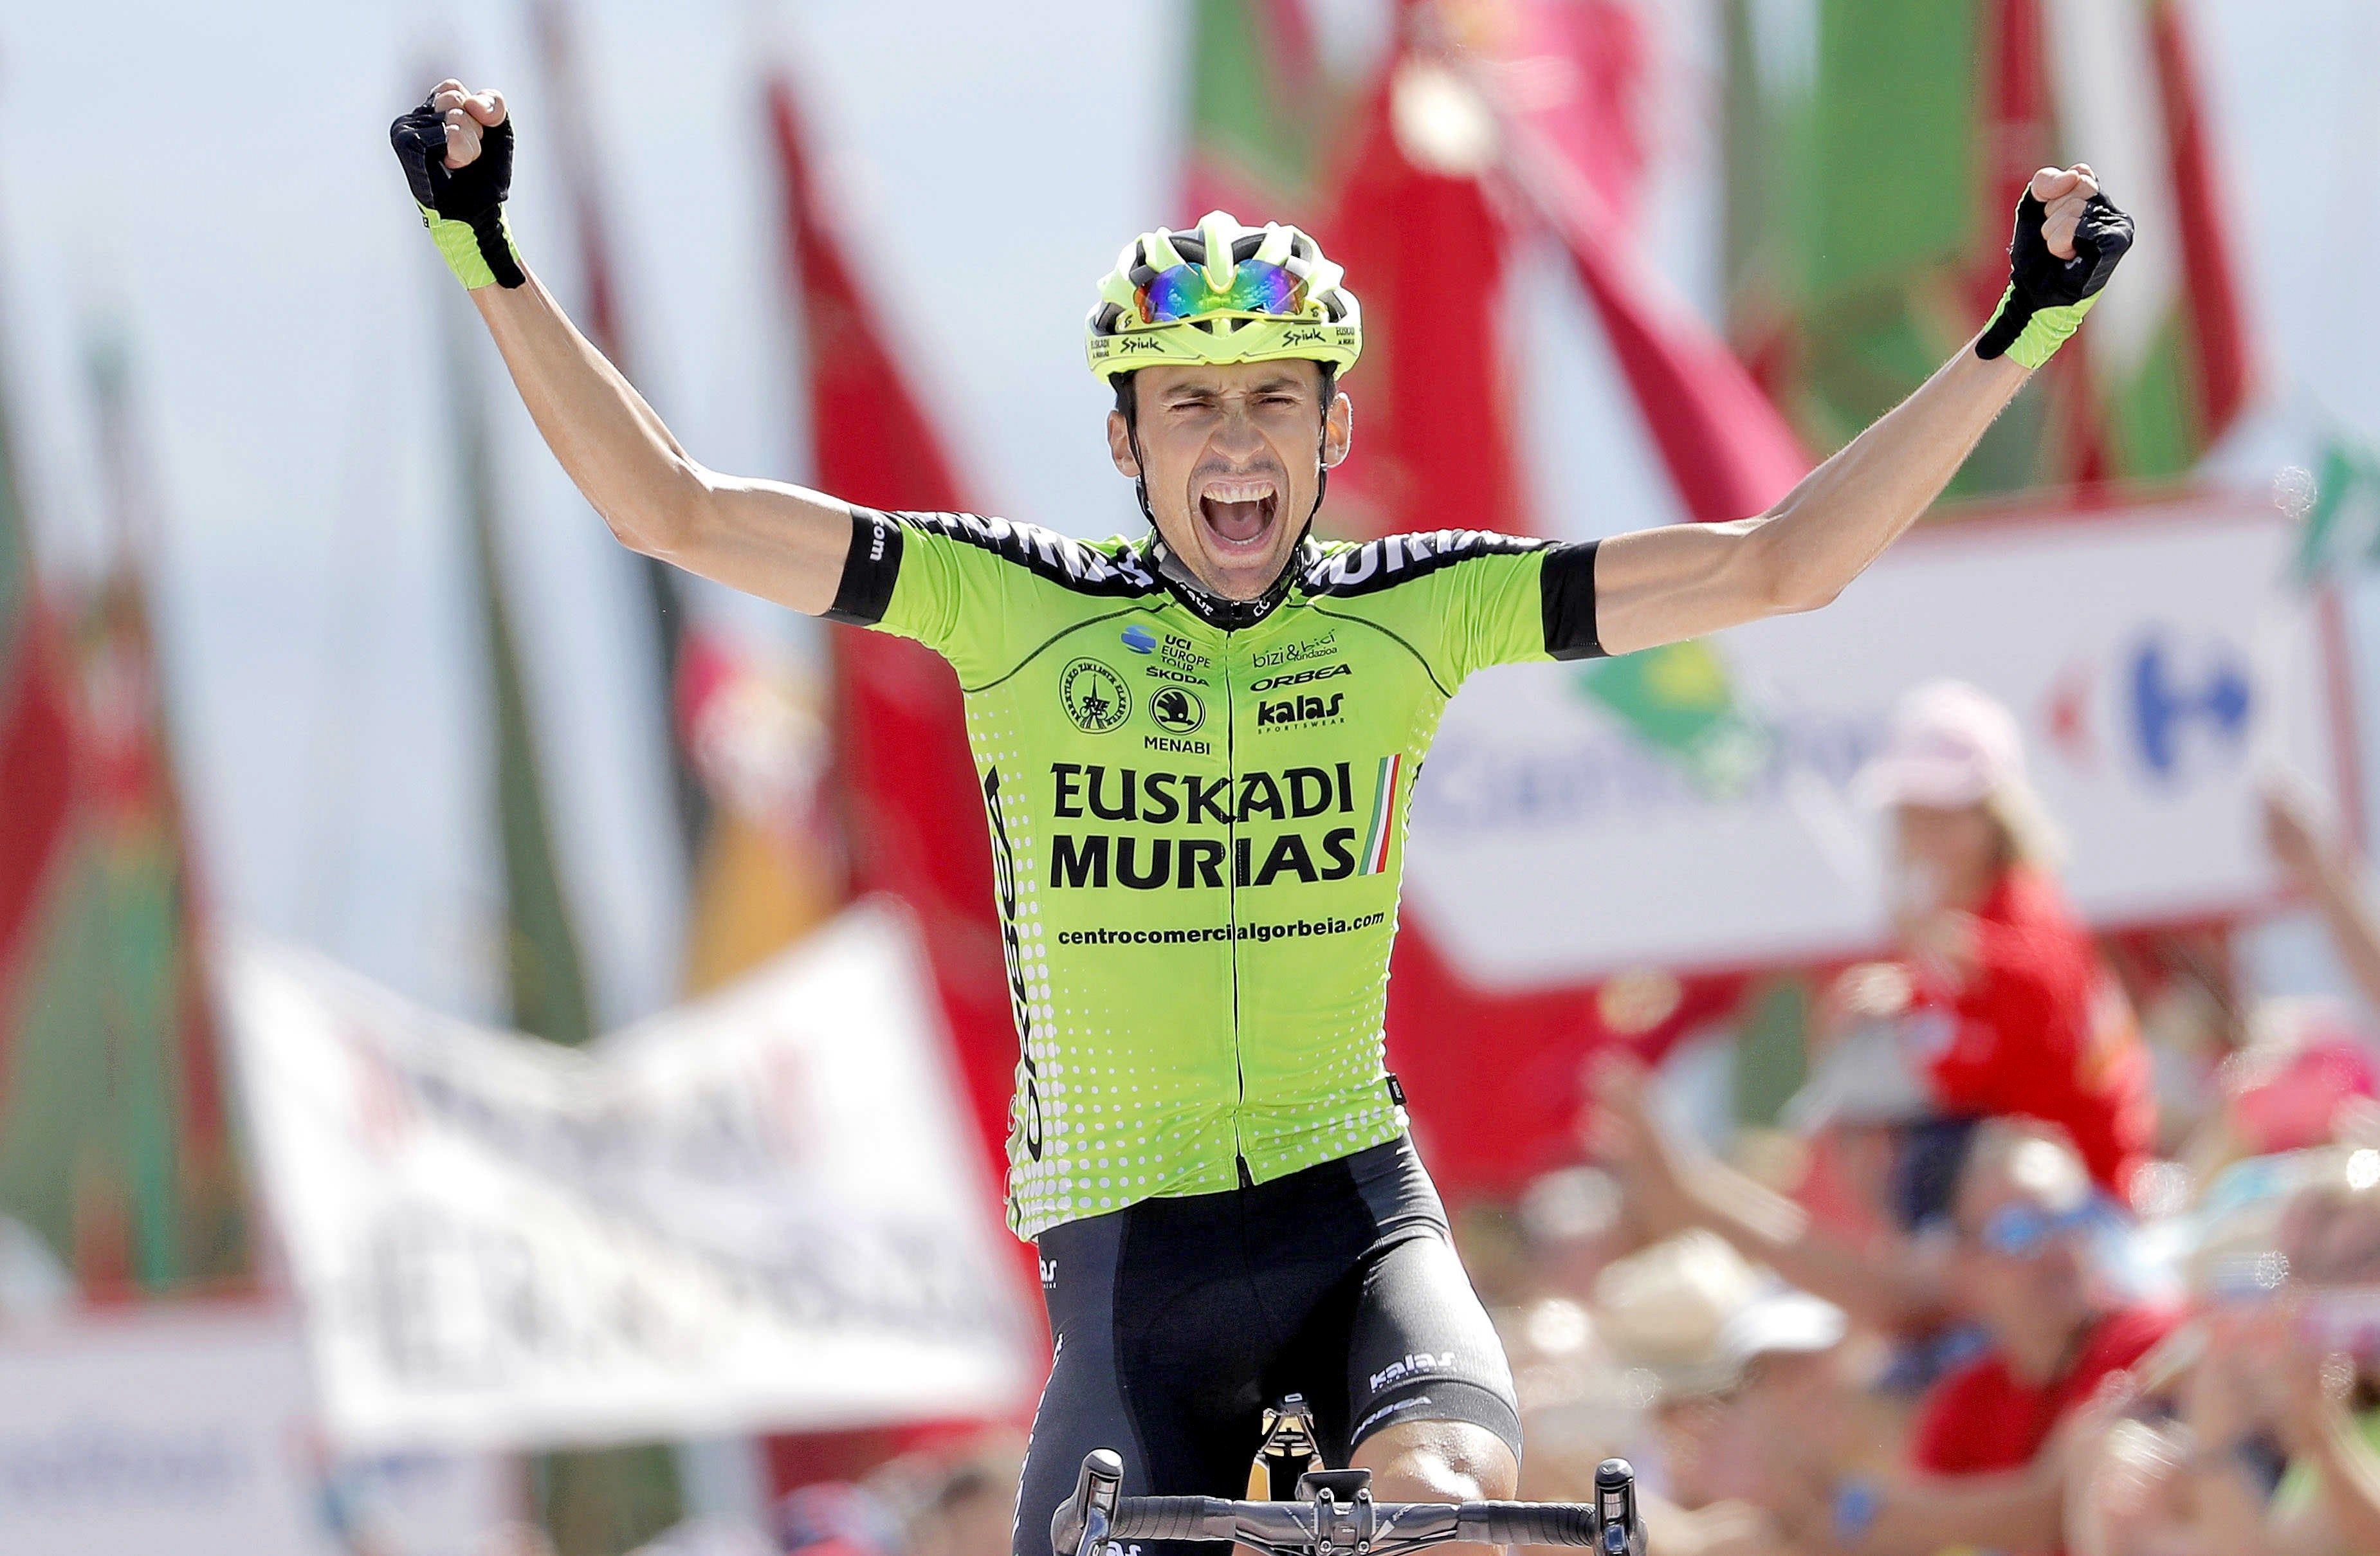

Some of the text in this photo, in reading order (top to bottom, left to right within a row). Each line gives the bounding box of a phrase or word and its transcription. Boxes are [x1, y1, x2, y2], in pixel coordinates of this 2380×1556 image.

[1121, 337, 1165, 353] Spiuk
[1282, 328, 1326, 347] Spiuk
[1165, 634, 1191, 650] UCI
[1160, 655, 1195, 673] TOUR
[1161, 645, 1211, 668] EUROPE
[1146, 665, 1211, 687] ŠKODA
[1250, 663, 1352, 691] ORBEA
[1258, 692, 1344, 726] kalas
[1258, 718, 1345, 735] SPORTSWEAR
[1144, 735, 1211, 755] MENABI
[1050, 761, 1355, 825] EUSKADI
[1050, 827, 1356, 889] MURIAS
[1058, 910, 1385, 945] centrocomercialgorbeia.com
[1369, 1352, 1456, 1385] kalas
